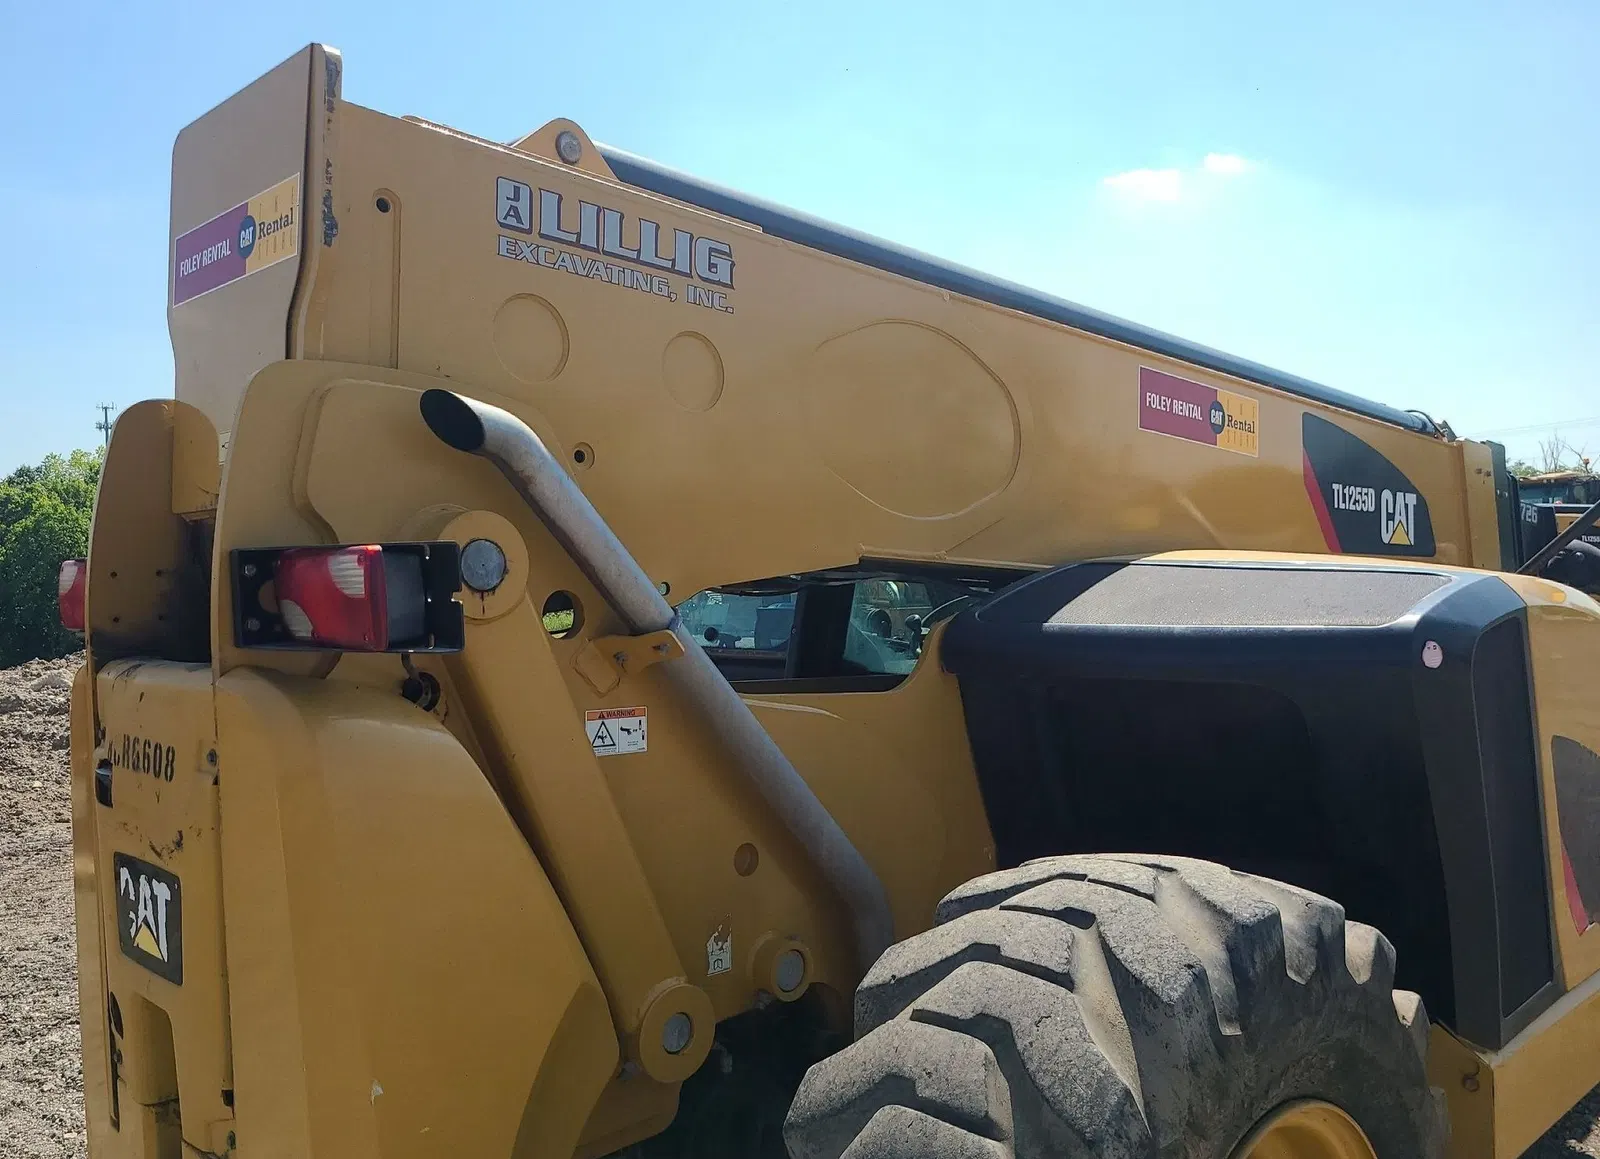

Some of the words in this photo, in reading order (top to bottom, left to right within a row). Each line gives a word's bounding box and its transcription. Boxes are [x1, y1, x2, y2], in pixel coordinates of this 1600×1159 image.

[240, 226, 254, 249] CAT
[258, 207, 294, 240] Rental
[539, 187, 736, 290] LILLIG
[180, 253, 201, 278] FOLEY
[202, 238, 231, 267] RENTAL
[498, 234, 677, 302] EXCAVATING,
[687, 283, 735, 314] INC.
[1146, 392, 1172, 412] FOLEY
[1173, 399, 1203, 421] RENTAL
[1210, 408, 1223, 426] CAT
[1226, 414, 1256, 434] Rental
[1332, 483, 1376, 513] TL1255D
[1381, 488, 1417, 546] CAT
[606, 709, 636, 718] WARNING
